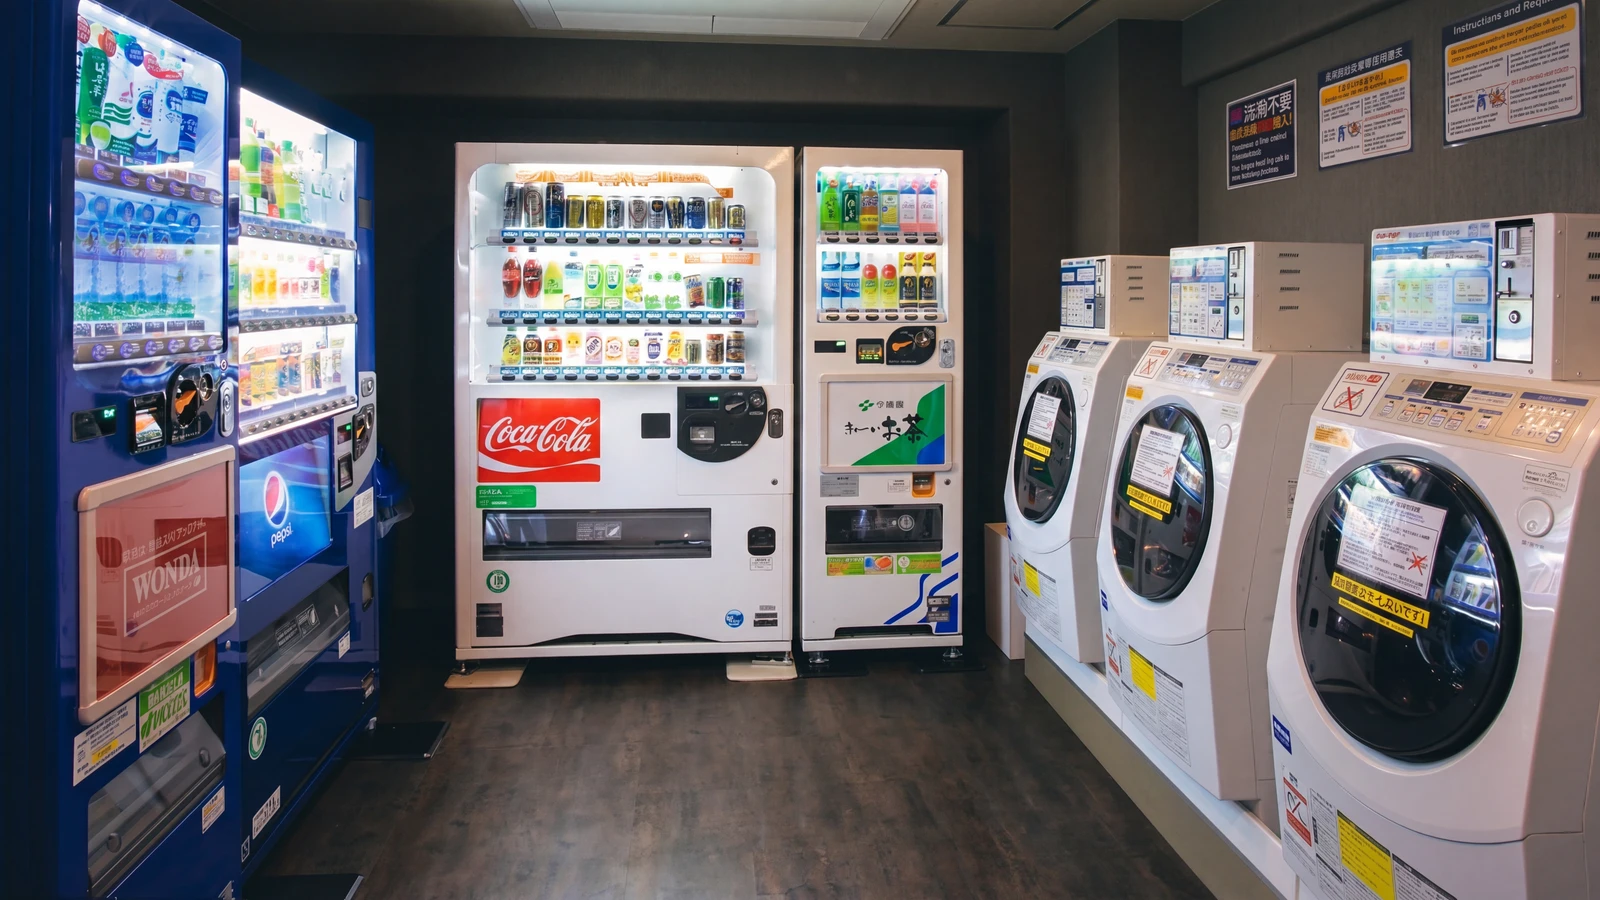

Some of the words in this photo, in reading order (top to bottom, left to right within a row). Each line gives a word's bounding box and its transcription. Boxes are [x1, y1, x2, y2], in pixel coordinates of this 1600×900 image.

[1503, 4, 1521, 18] and
[484, 416, 599, 453] Coca-Cola
[270, 522, 292, 549] pepsi
[132, 548, 201, 604] WONDA
